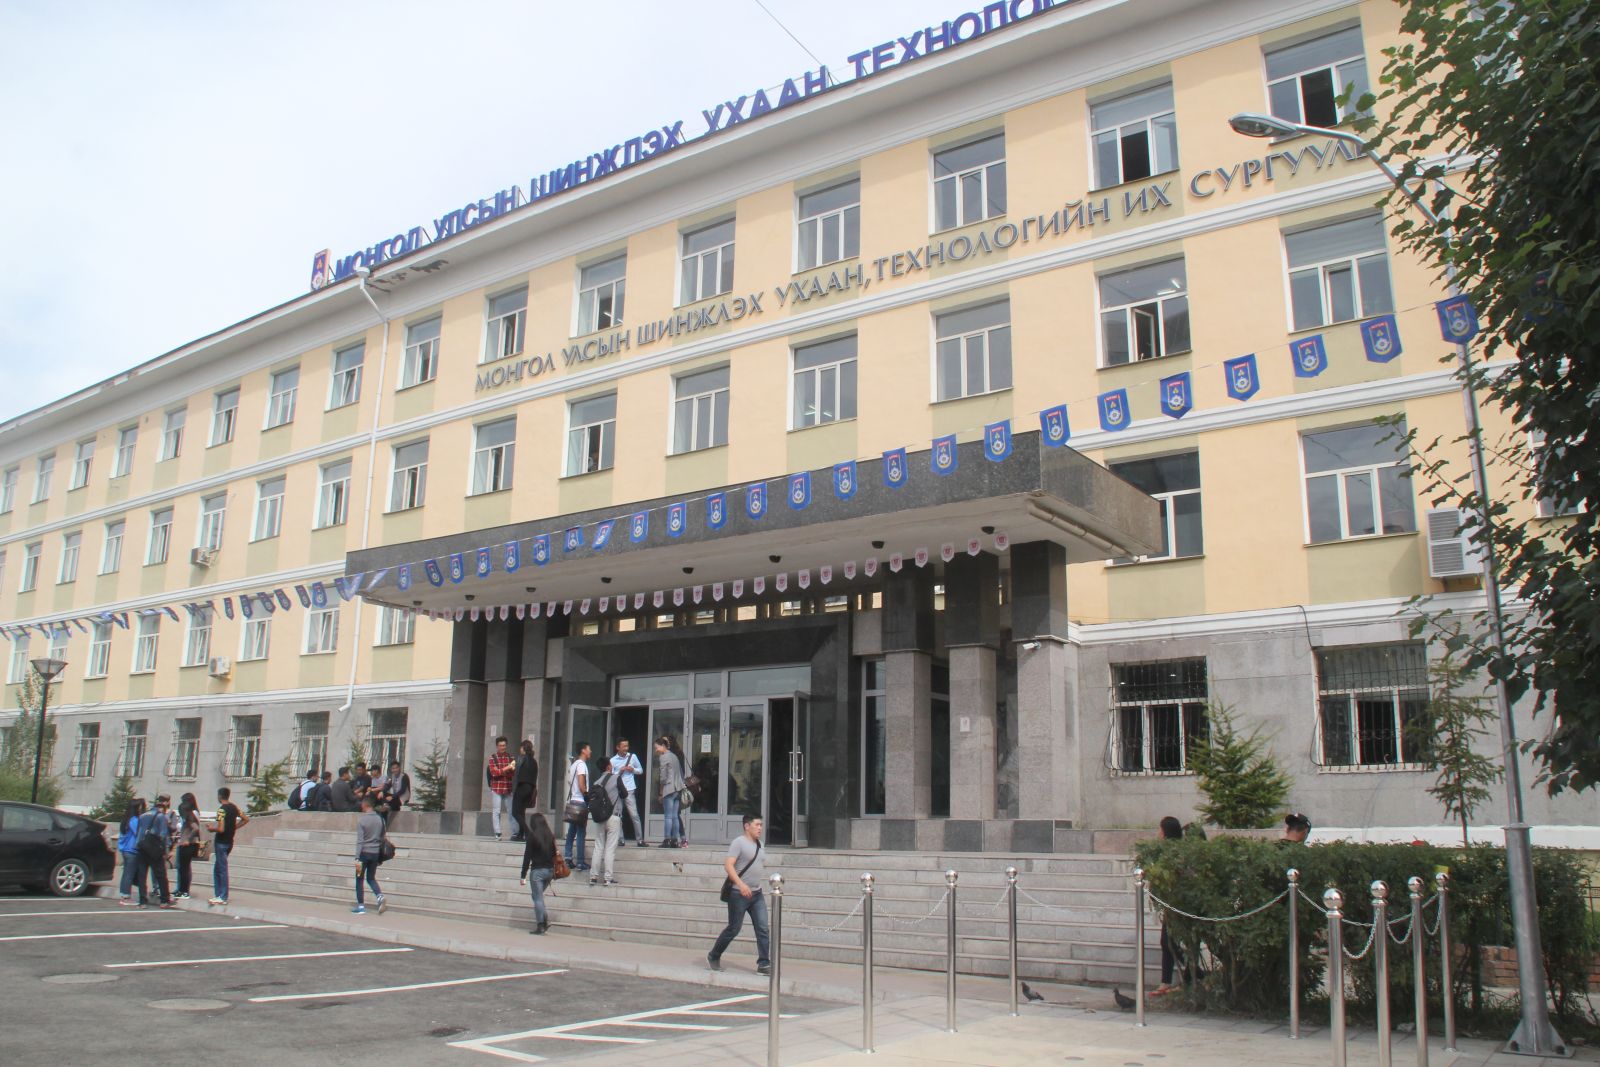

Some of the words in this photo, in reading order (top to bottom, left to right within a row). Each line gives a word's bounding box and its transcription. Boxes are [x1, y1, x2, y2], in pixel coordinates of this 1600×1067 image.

[702, 65, 829, 136] УХААН
[475, 351, 556, 392] МОНГОЛ
[562, 329, 631, 368] УЛСЫН
[637, 291, 764, 346] ШИНЖЛЭХ
[1123, 180, 1173, 217] ИХ
